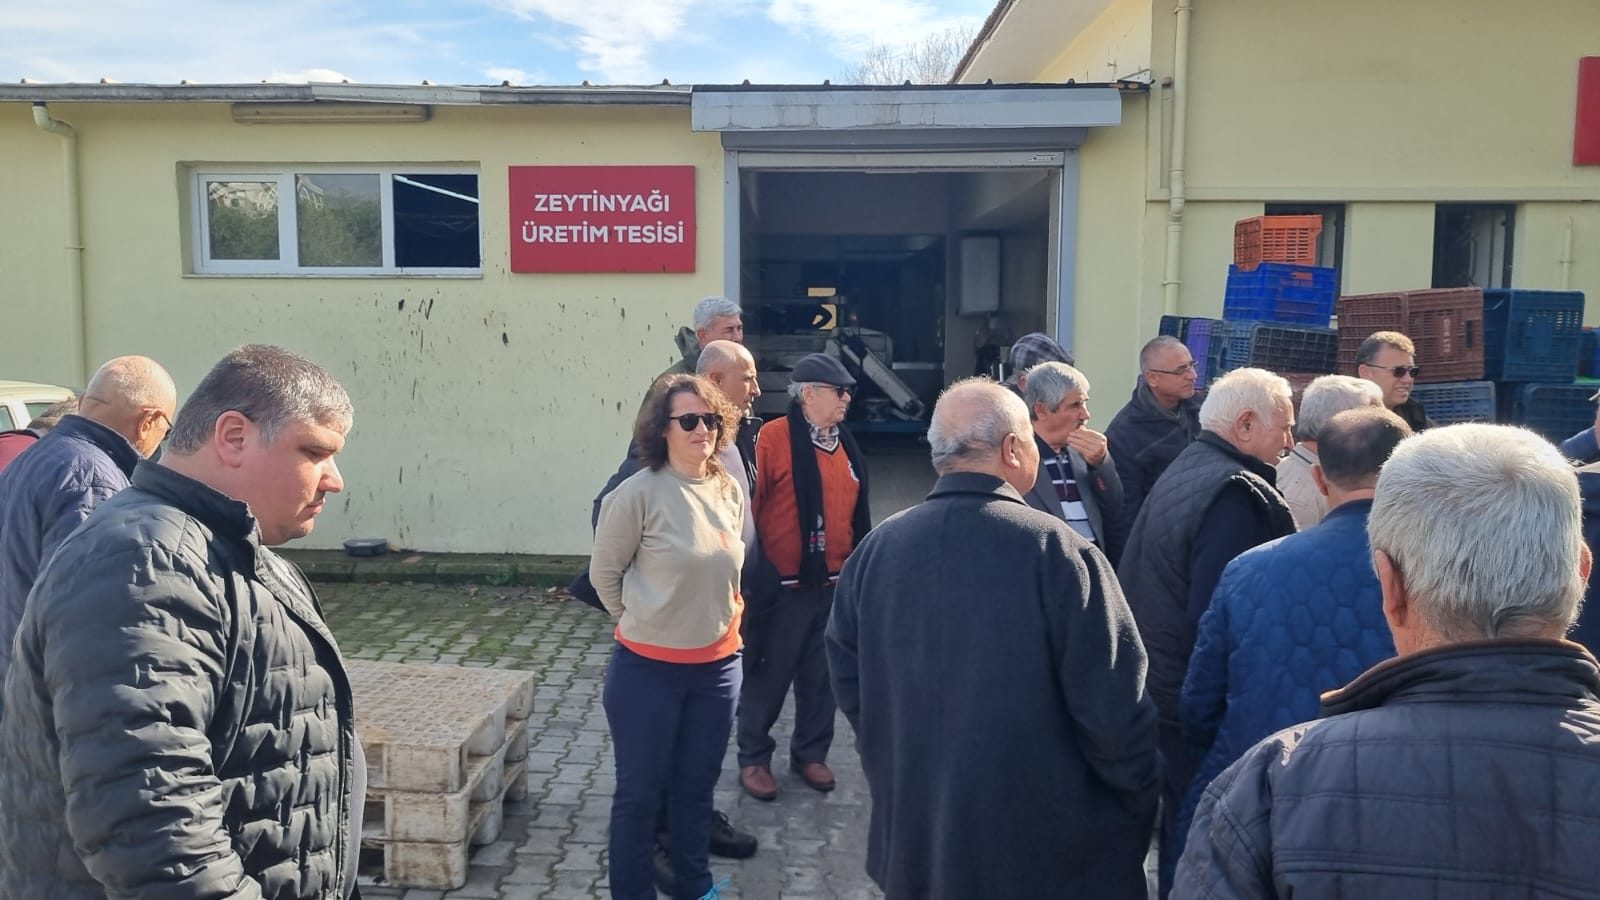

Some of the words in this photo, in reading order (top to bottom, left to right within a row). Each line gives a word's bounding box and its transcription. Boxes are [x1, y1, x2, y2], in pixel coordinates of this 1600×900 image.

[534, 189, 670, 212] ZEYTİNYAĞI
[522, 220, 609, 243] ÜRETİM
[613, 220, 684, 243] TESİSİ
